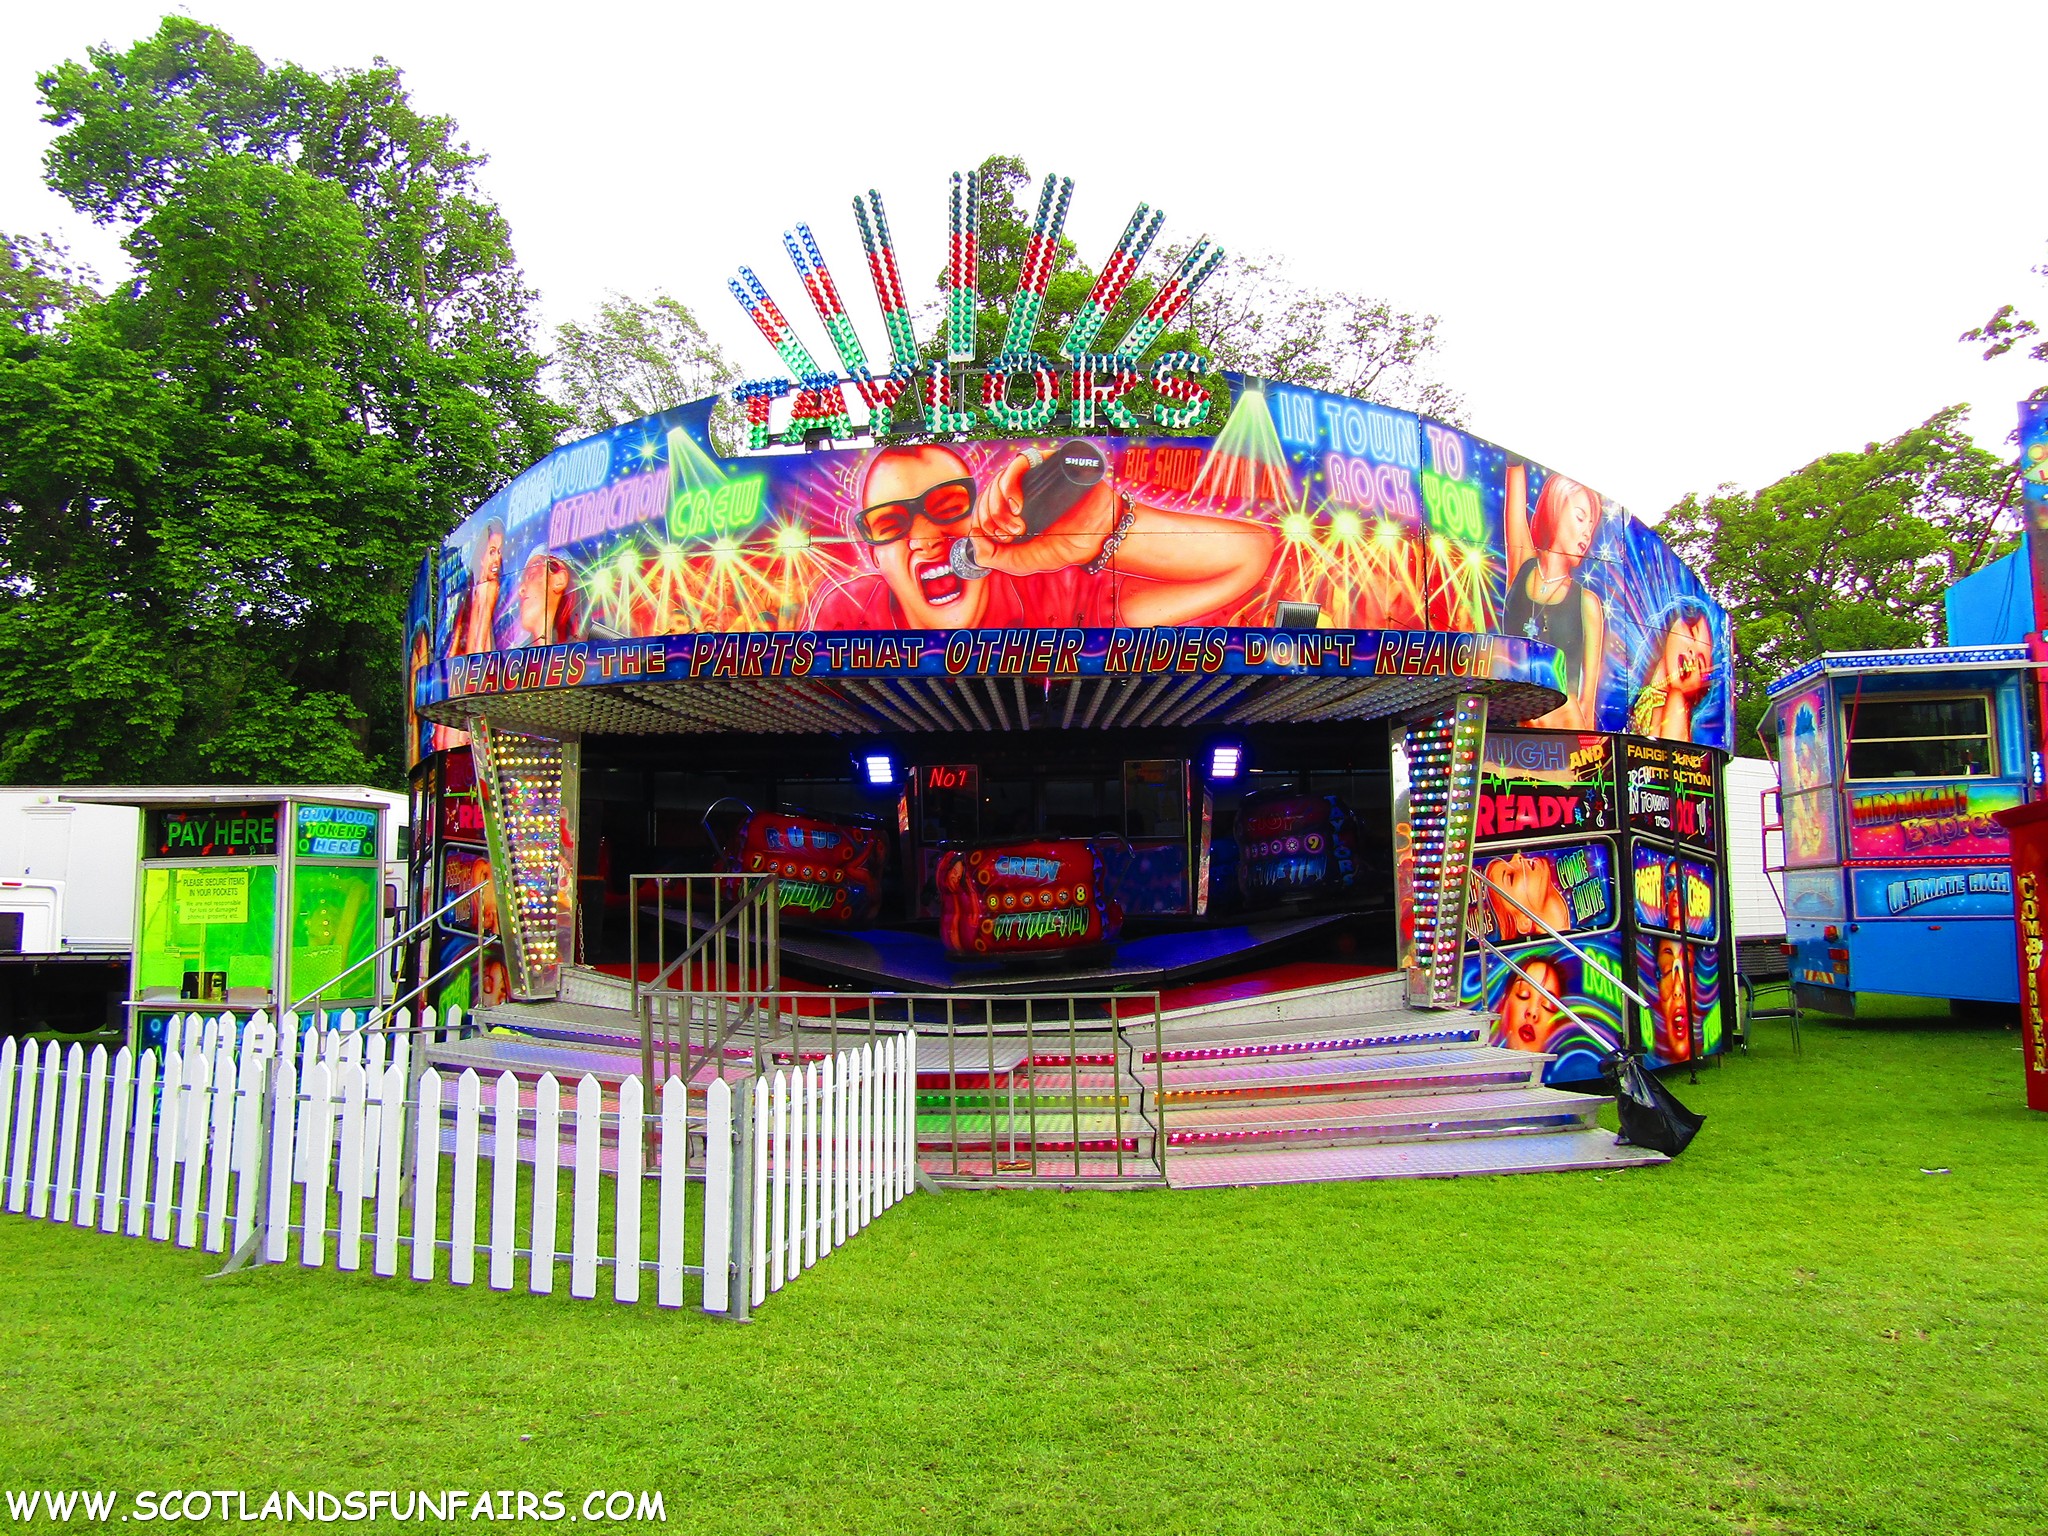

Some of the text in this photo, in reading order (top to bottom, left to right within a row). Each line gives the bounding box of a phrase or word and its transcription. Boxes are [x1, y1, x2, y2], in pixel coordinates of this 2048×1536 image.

[731, 350, 1210, 450] TAYLORS
[1279, 392, 1464, 481] IN TOWN TO
[1065, 456, 1100, 468] SHURE
[1124, 448, 1151, 483] BIG
[549, 465, 671, 550] ATTRACTION
[669, 476, 767, 538] CREW
[1328, 453, 1482, 539] ROCK YOU
[448, 627, 1497, 697] REACHES THE PARTS THAT OTHER RIDES DON'T REACH
[1482, 737, 1605, 772] UGH AND
[1475, 793, 1580, 837] READY
[1640, 790, 1670, 814] TOWN
[1853, 783, 1970, 828] MIDNIGHT
[307, 822, 367, 839] TOKENS
[335, 809, 375, 826] YOUR
[1654, 815, 1670, 829] TO
[167, 818, 275, 848] PAY HERE
[312, 838, 361, 853] HERE
[786, 826, 804, 848] U
[811, 829, 841, 849] UP
[1308, 835, 1320, 850] 9
[754, 855, 762, 869] 7
[994, 855, 1061, 882] CREW
[183, 878, 204, 887] PLEASE
[205, 877, 227, 887] SECURE
[189, 887, 239, 897] IN YOUR POCKETS
[1076, 886, 1086, 901] 8
[1887, 871, 2011, 914] ULTIMATE HIGH
[990, 897, 997, 907] 8
[993, 906, 1090, 941] ATTRACTION
